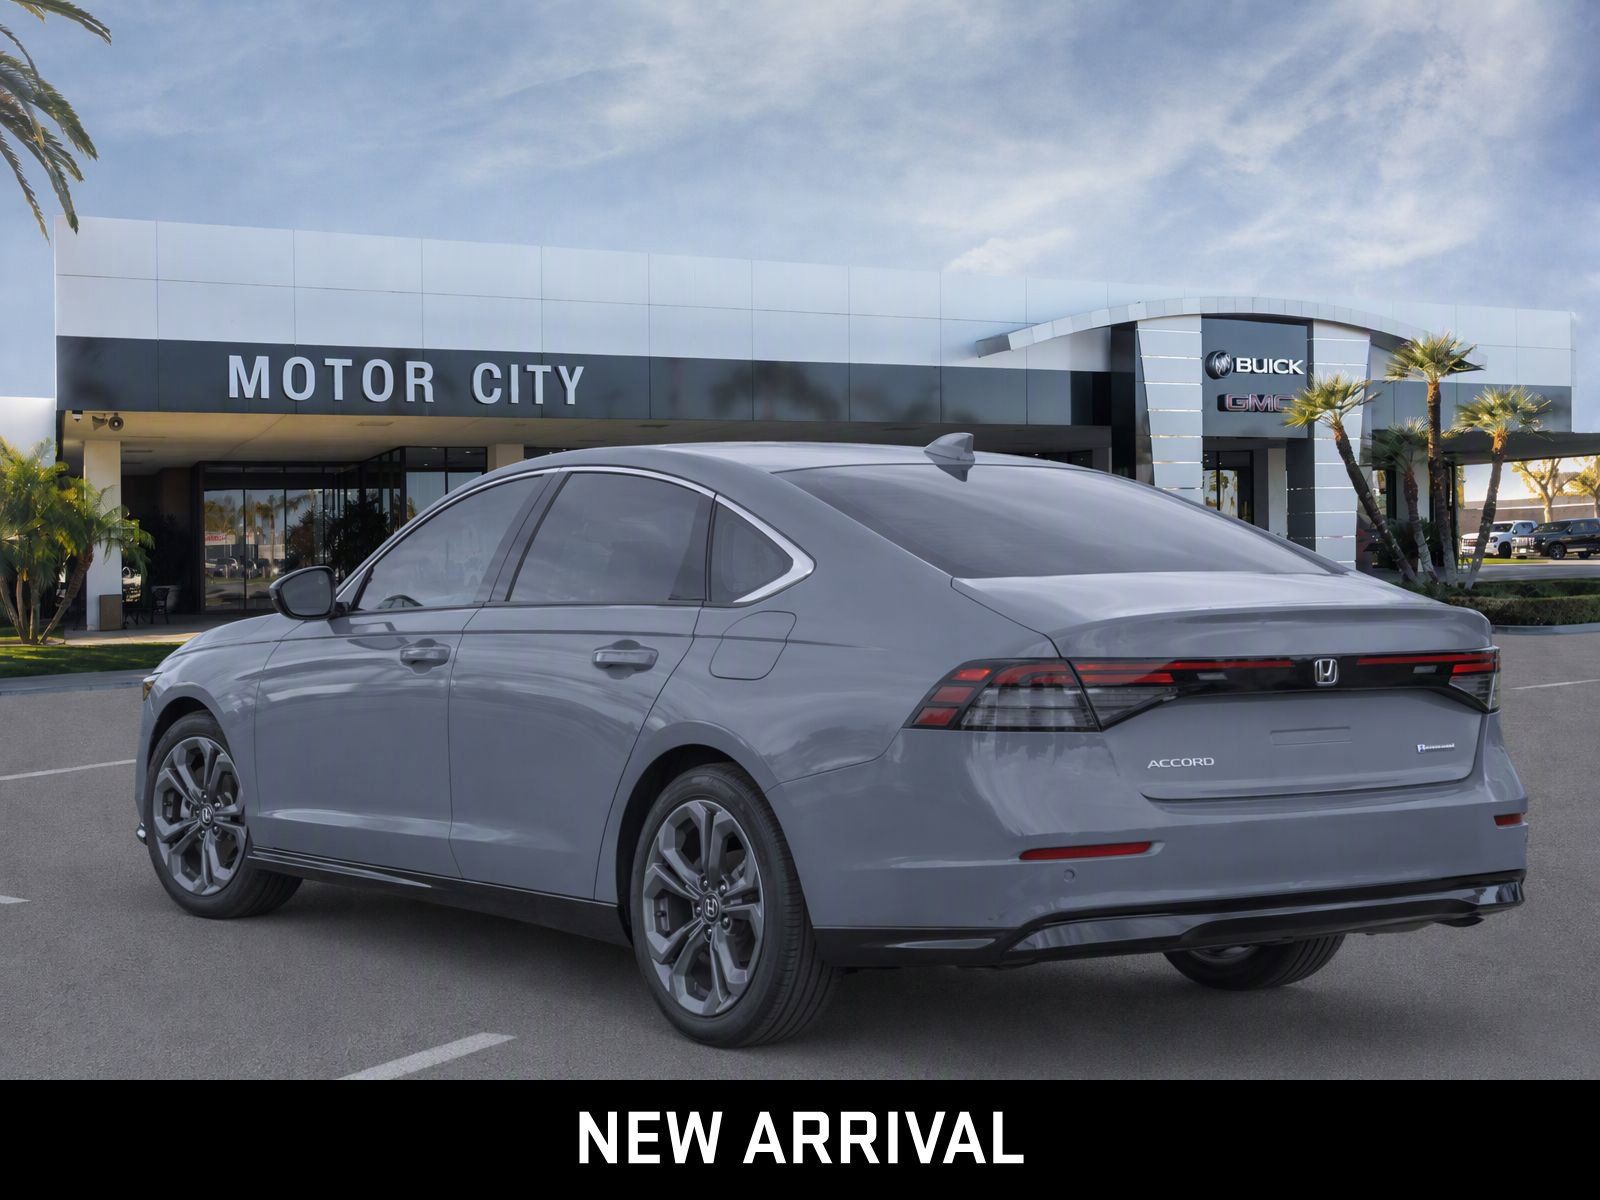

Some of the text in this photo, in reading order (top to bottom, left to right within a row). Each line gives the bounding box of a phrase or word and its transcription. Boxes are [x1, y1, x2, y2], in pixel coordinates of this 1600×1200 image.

[1236, 357, 1304, 375] BUICK
[228, 355, 585, 405] MOTOR CITY
[1225, 394, 1295, 412] GMC
[1147, 757, 1215, 769] ACCORD
